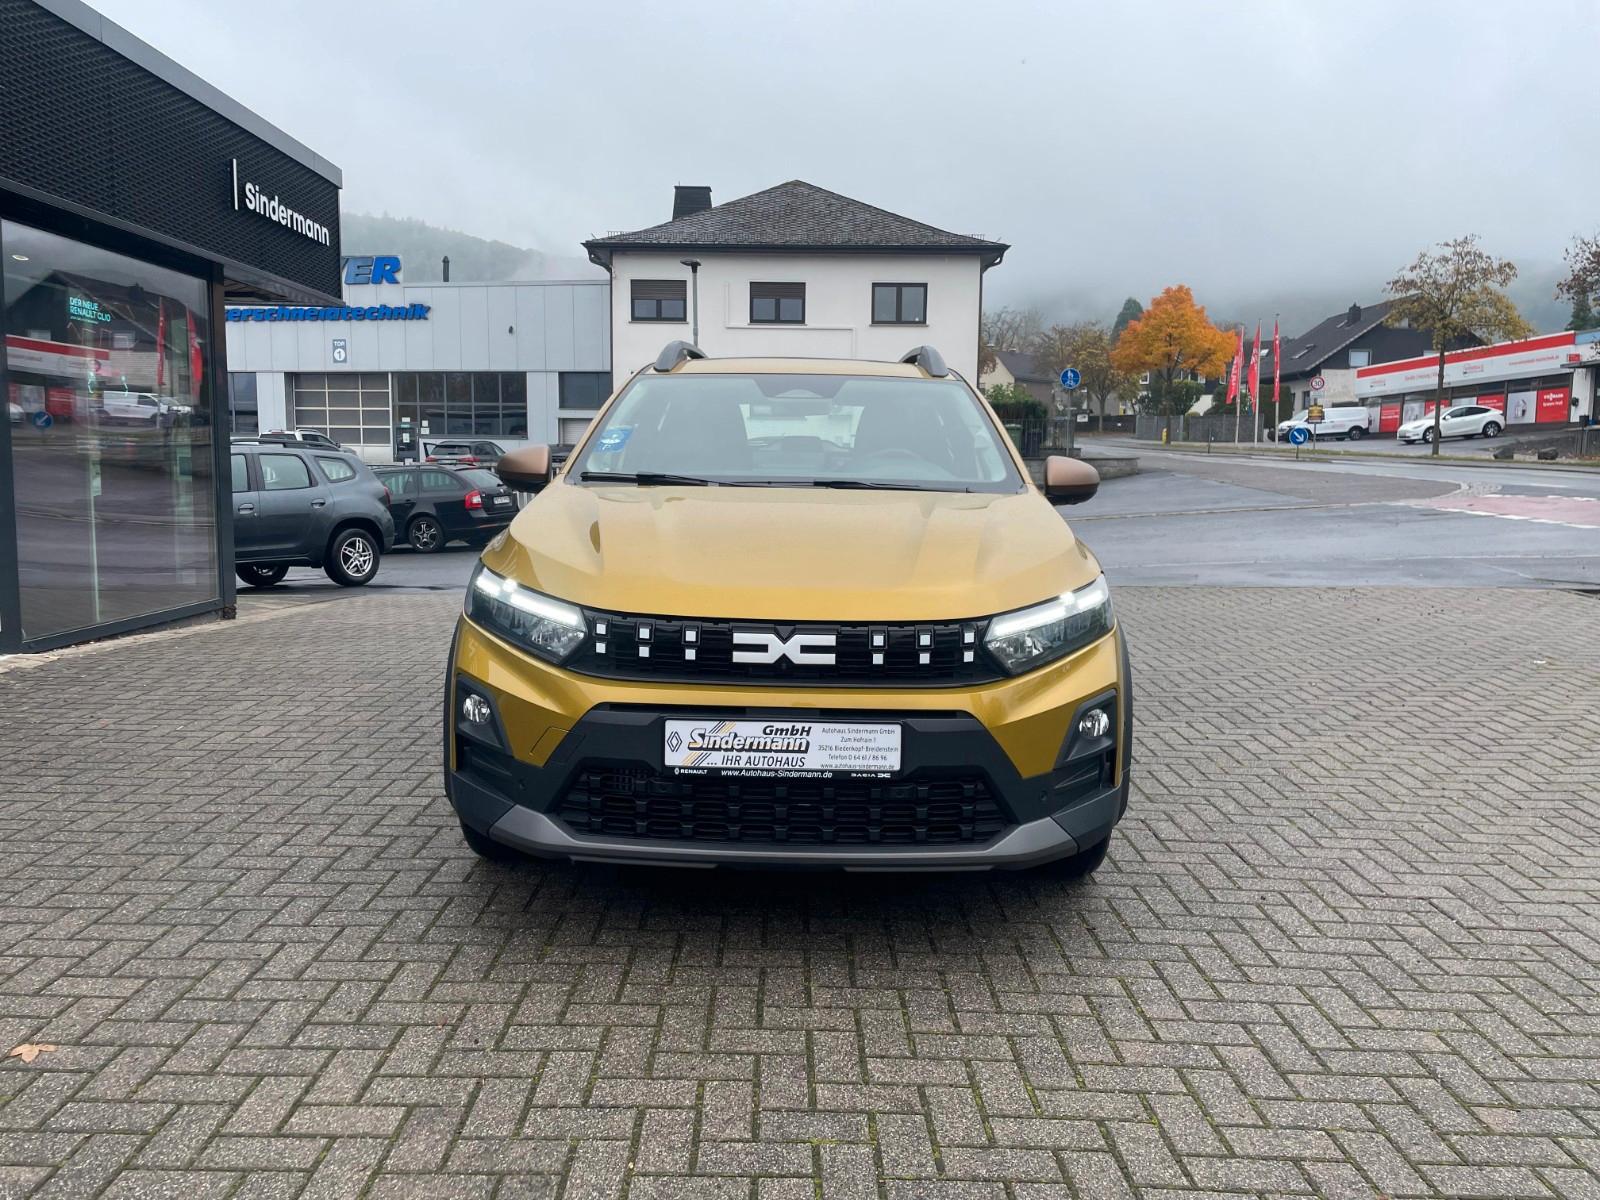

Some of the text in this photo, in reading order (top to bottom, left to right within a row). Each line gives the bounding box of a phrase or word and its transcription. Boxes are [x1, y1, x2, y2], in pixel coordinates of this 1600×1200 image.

[245, 182, 330, 247] Sindermann
[341, 255, 402, 285] ER
[69, 296, 99, 311] DER NEUE
[69, 305, 96, 319] RENAULT
[97, 312, 111, 322] CLIO
[225, 303, 431, 322] erschneidtechnik
[1313, 379, 1322, 387] 30
[762, 725, 812, 737] GmbH
[847, 727, 879, 735] Sindermann
[688, 728, 810, 753] Sindermann
[721, 755, 741, 766] IHR
[745, 755, 806, 767] AUTOHAUS
[721, 769, 833, 779] www.Autohaus-Sindermann.de
